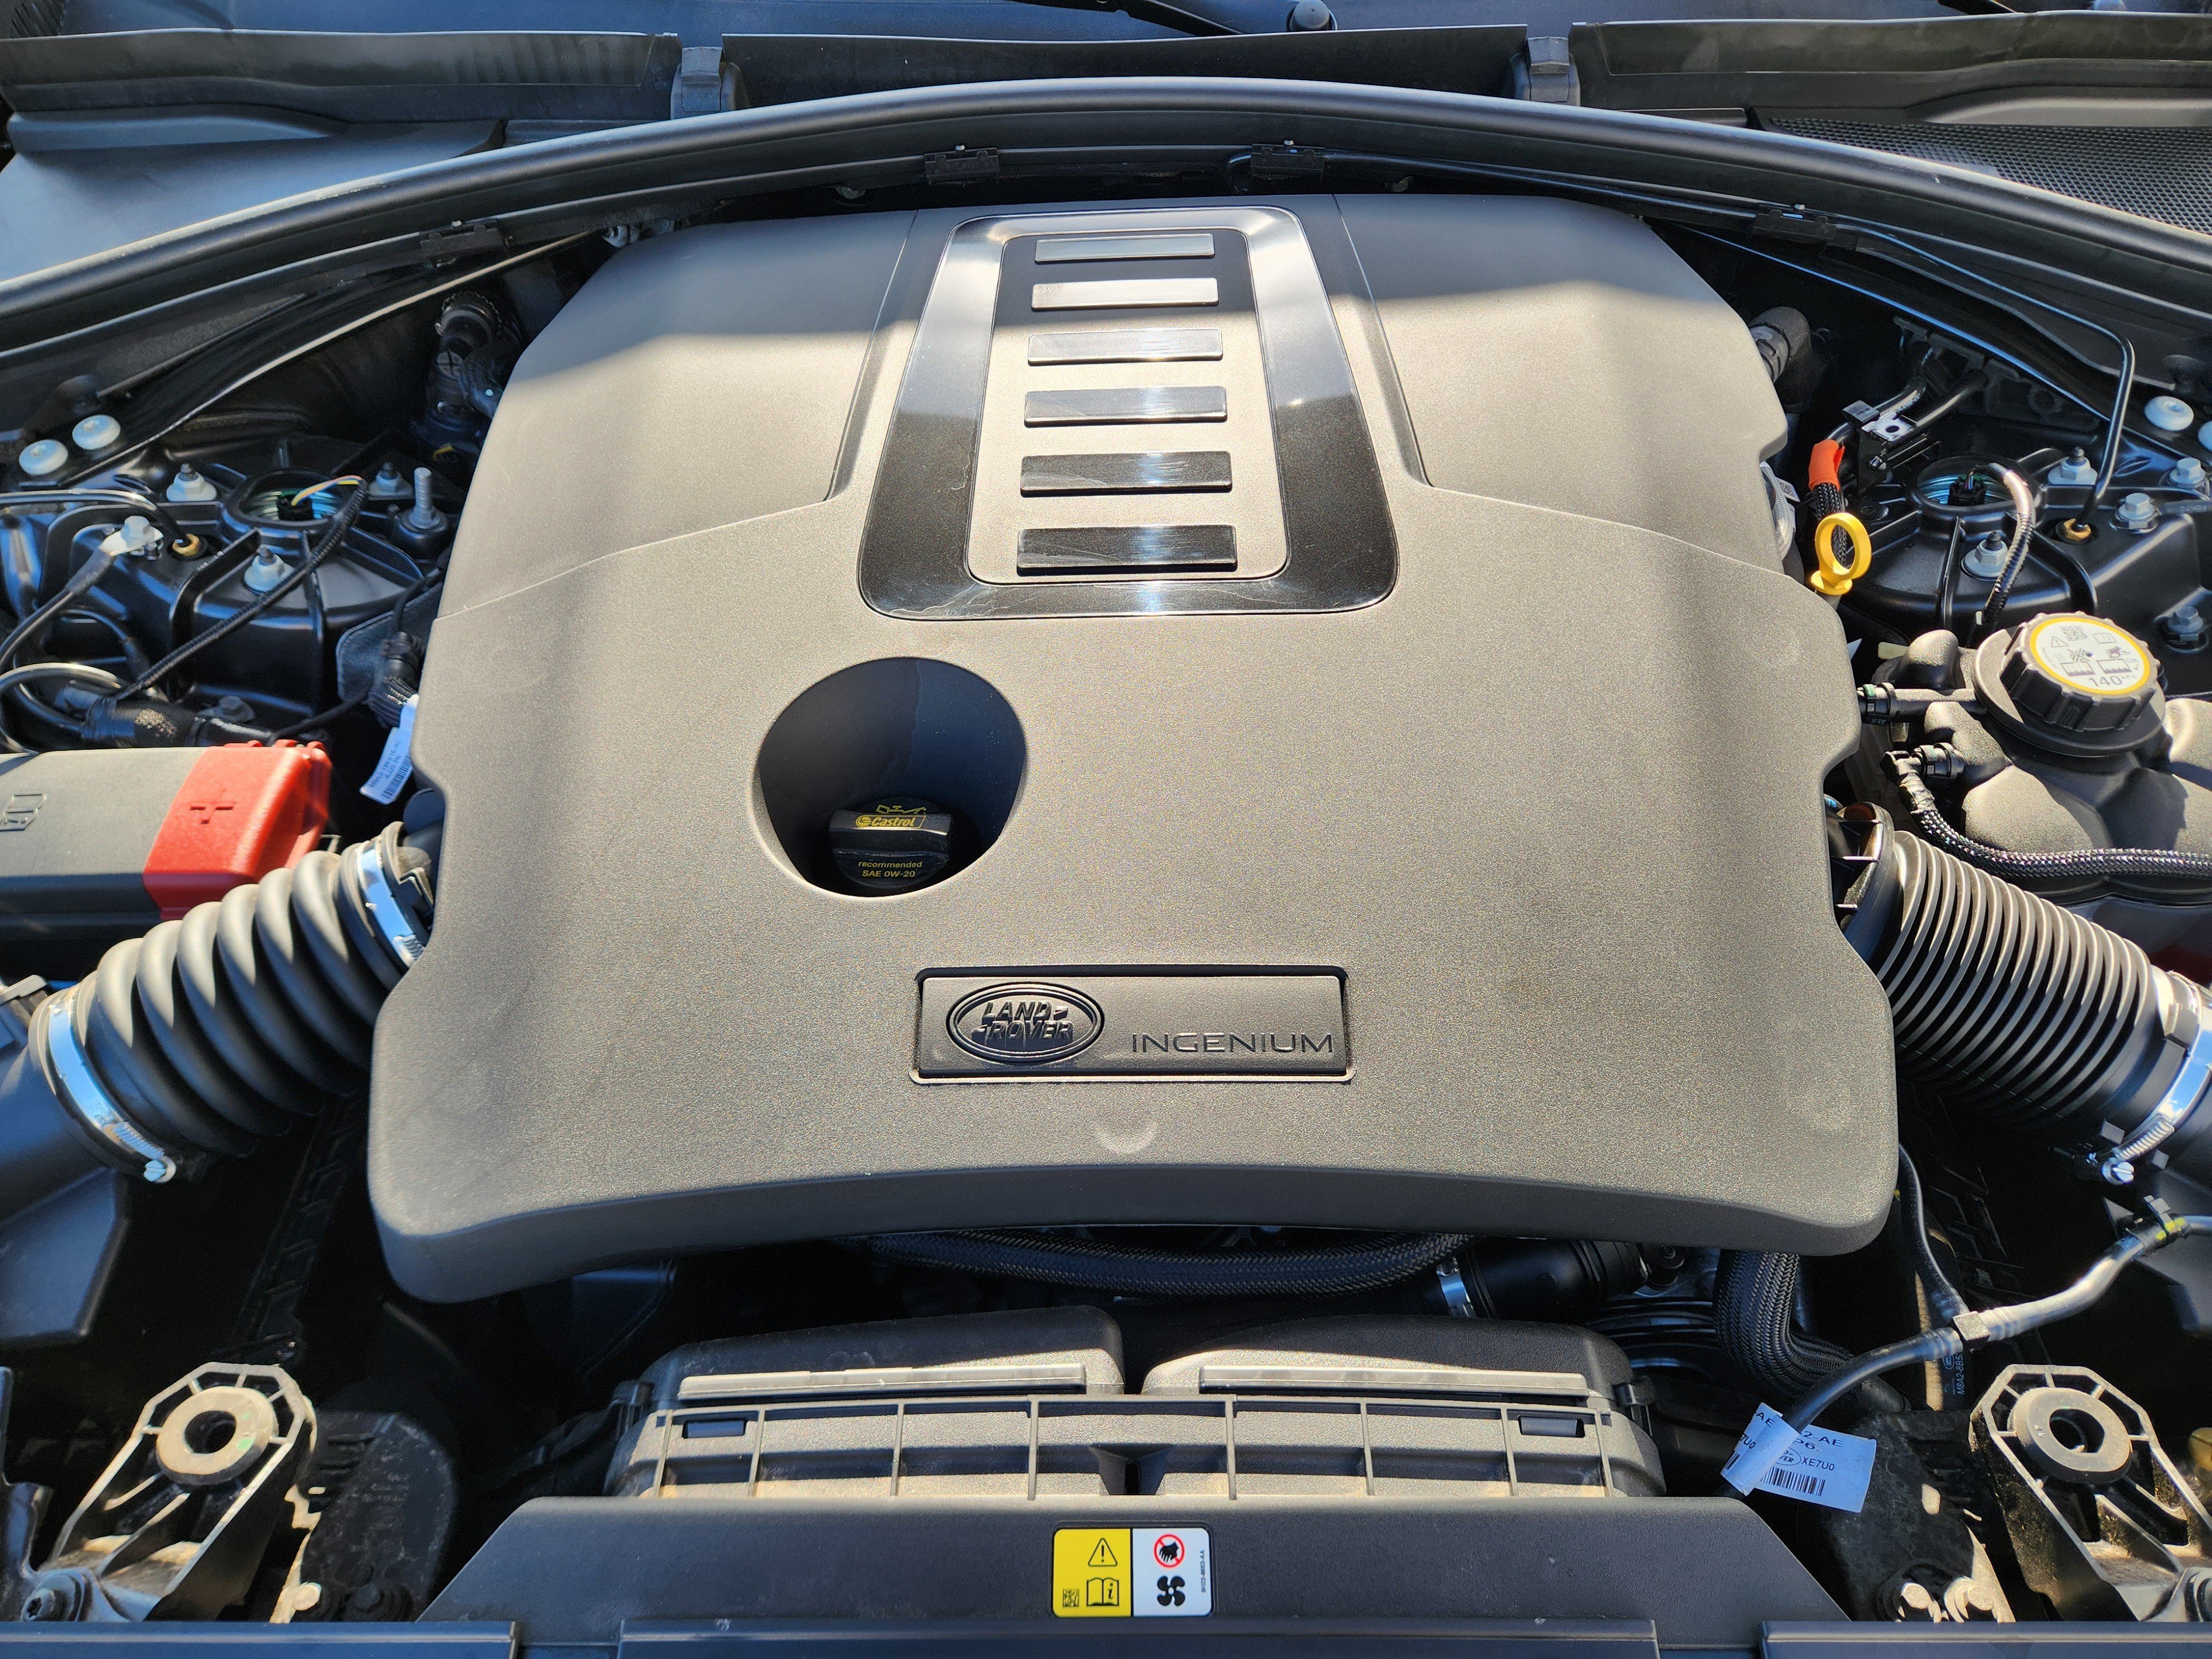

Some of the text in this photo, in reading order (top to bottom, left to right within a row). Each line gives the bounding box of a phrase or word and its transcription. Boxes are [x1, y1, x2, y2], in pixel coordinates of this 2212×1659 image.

[2089, 675, 2122, 687] 140
[871, 816, 916, 827] Castrol
[987, 1020, 1073, 1041] ROVER
[1132, 1032, 1333, 1053] INGENIUM
